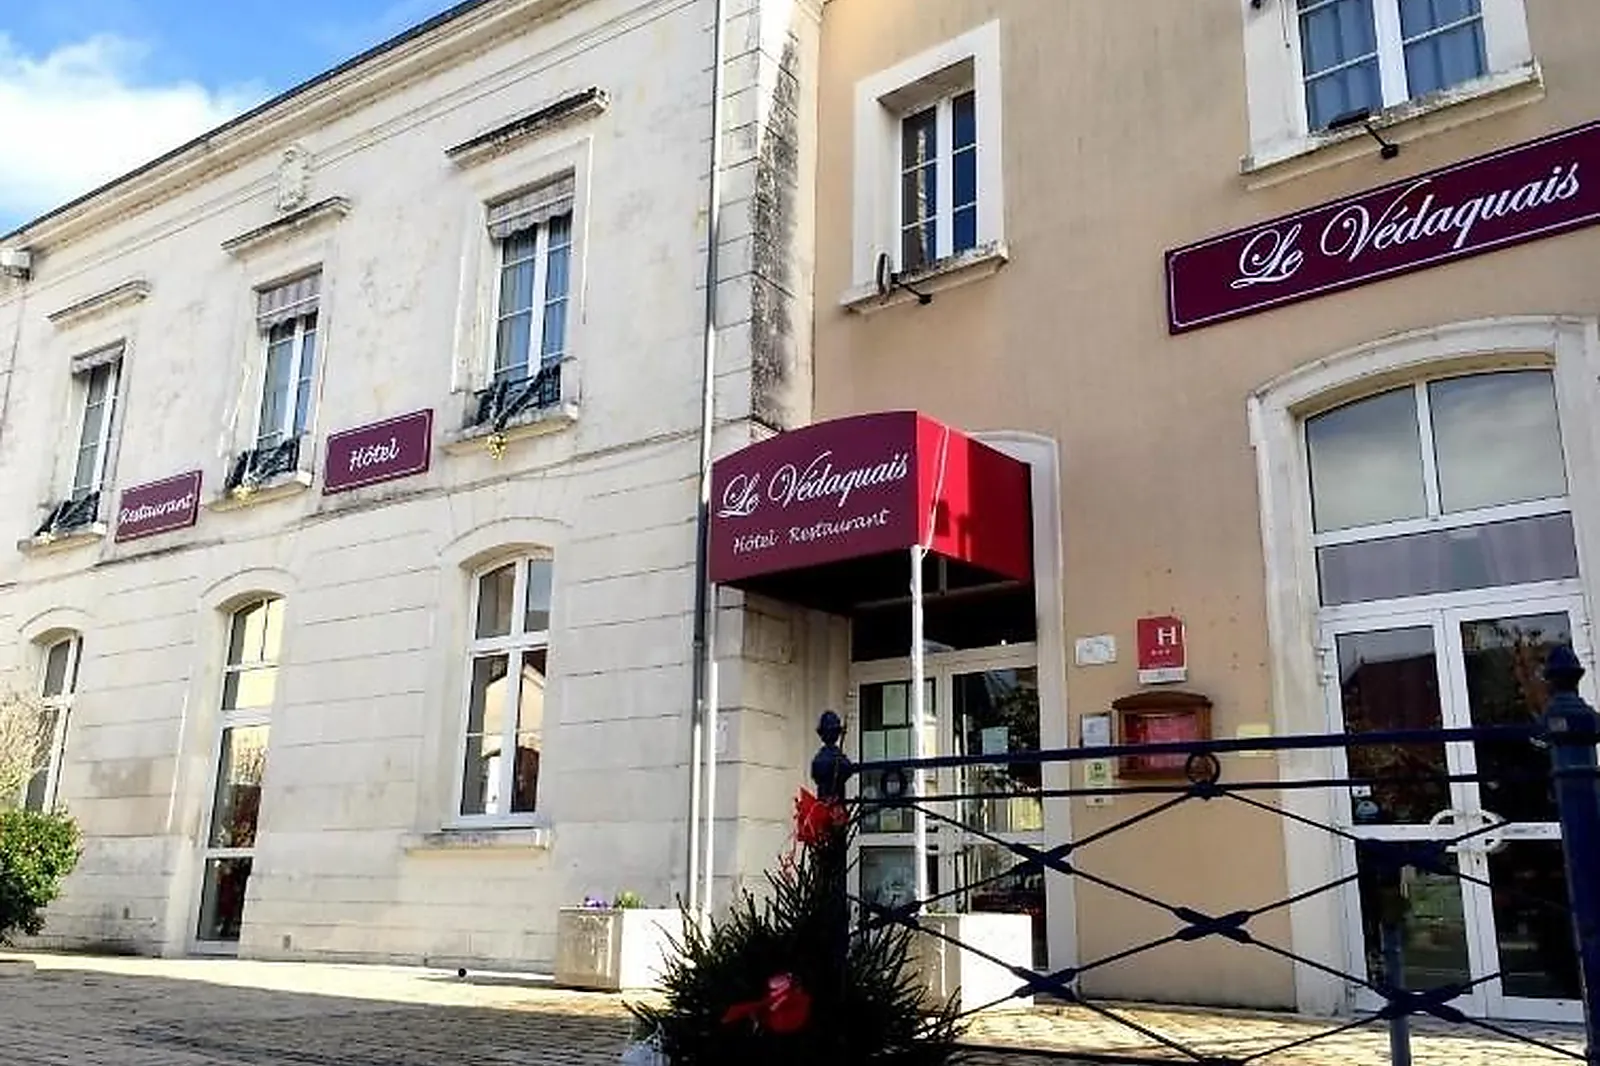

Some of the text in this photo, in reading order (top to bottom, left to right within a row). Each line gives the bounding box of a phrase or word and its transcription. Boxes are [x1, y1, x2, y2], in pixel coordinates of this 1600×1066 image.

[1230, 162, 1580, 289] Le Védaquais
[348, 437, 400, 472] Hôtel
[717, 450, 909, 518] Le Védaquais
[119, 492, 195, 524] Restaurant
[733, 508, 890, 554] Hôtel Restaurant
[1157, 626, 1177, 646] H
